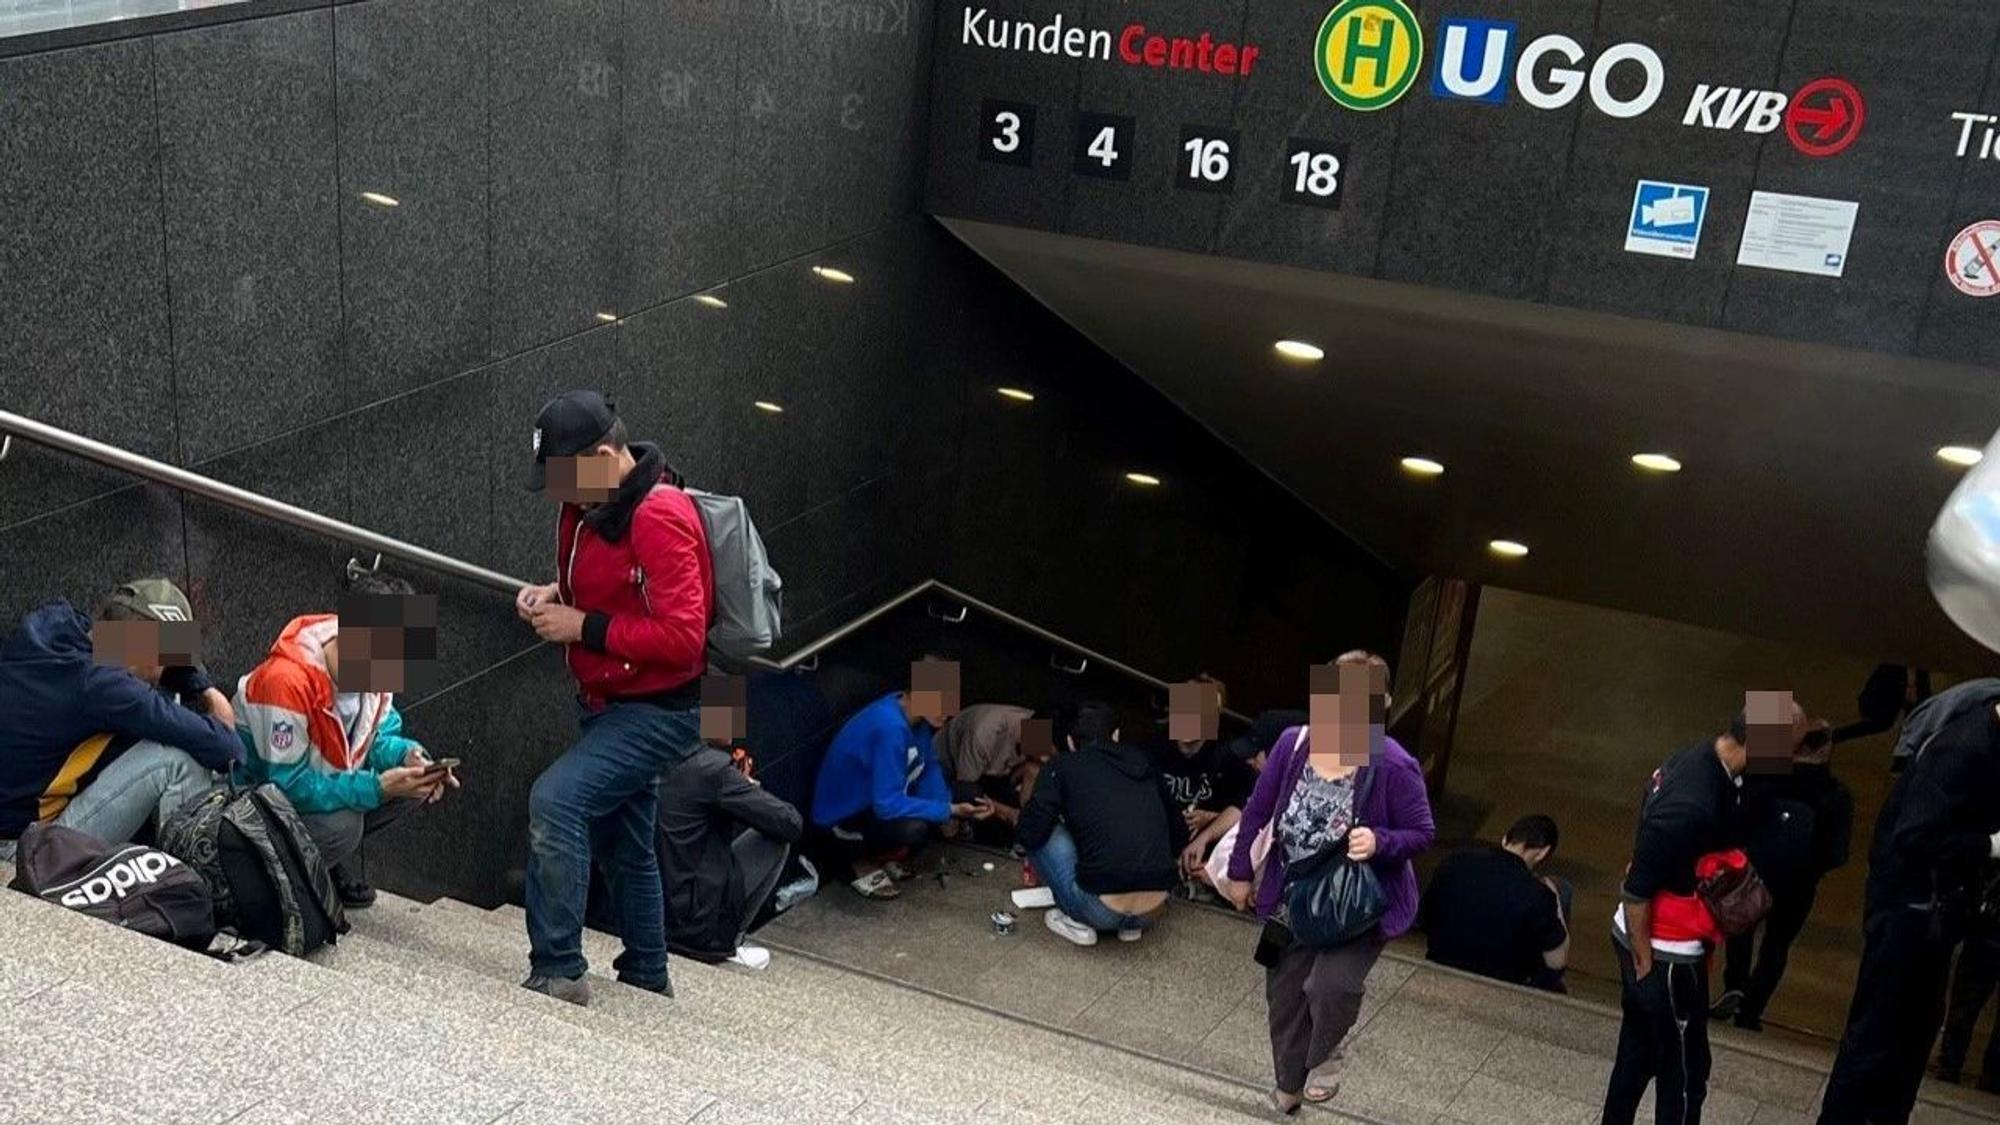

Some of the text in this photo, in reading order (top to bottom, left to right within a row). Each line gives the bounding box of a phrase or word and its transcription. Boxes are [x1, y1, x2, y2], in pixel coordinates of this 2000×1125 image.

[1341, 15, 1395, 88] H
[1683, 84, 1788, 134] KVB
[992, 112, 1340, 197] 3 4 16 18
